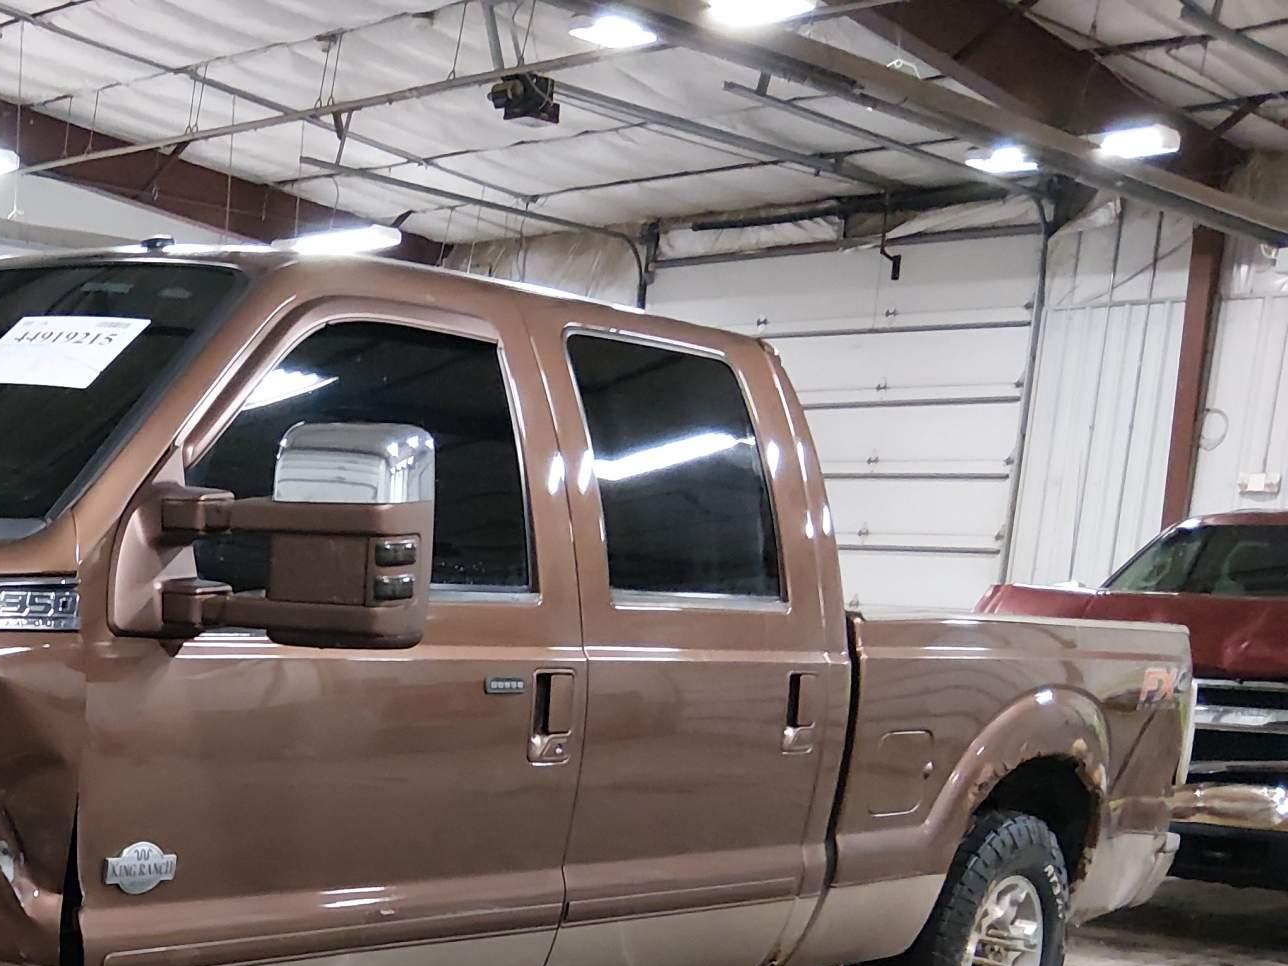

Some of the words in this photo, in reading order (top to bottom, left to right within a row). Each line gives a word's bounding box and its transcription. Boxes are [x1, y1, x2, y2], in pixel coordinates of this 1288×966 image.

[14, 331, 118, 345] 44919215
[112, 862, 136, 877] KING
[138, 860, 174, 876] RANCH
